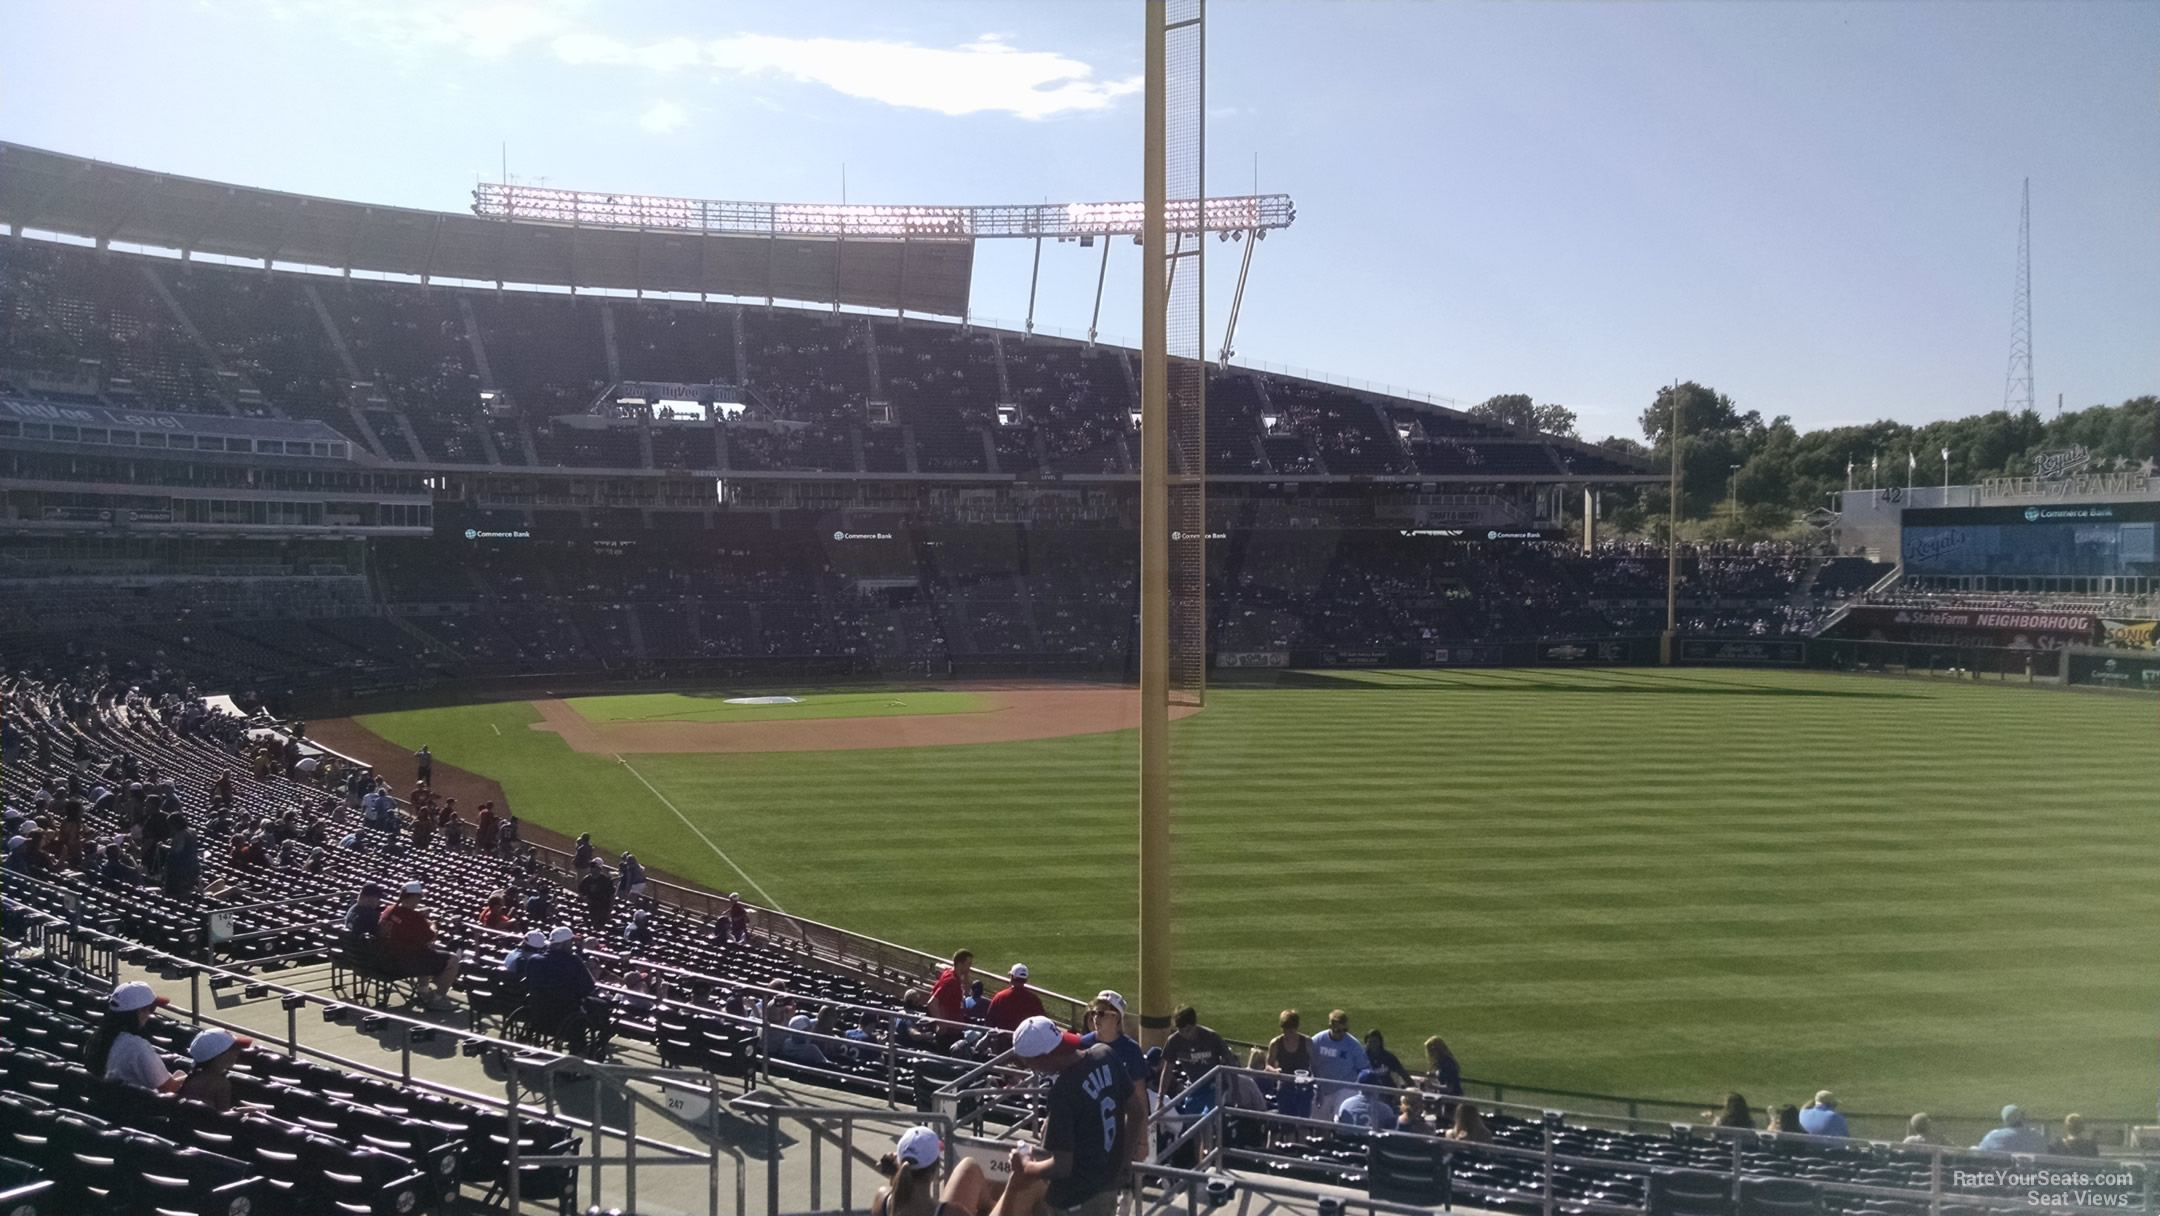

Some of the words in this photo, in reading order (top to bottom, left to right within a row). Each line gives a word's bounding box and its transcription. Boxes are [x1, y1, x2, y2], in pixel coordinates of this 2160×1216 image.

[104, 410, 185, 429] Level
[2032, 443, 2090, 479] Royals
[1982, 477, 2046, 498] HALL
[2051, 478, 2073, 500] of
[2072, 472, 2150, 496] FAME
[1881, 487, 1901, 503] 42
[2040, 508, 2089, 518] Commerce
[477, 530, 513, 538] Commerce
[513, 530, 531, 538] Bank
[1905, 529, 1965, 561] Royals
[2103, 627, 2153, 641] SONIC
[218, 911, 233, 921] 147
[1319, 1046, 1337, 1058] THE
[668, 1097, 685, 1110] 247
[1100, 1096, 1117, 1152] 6
[990, 1159, 1011, 1173] 248
